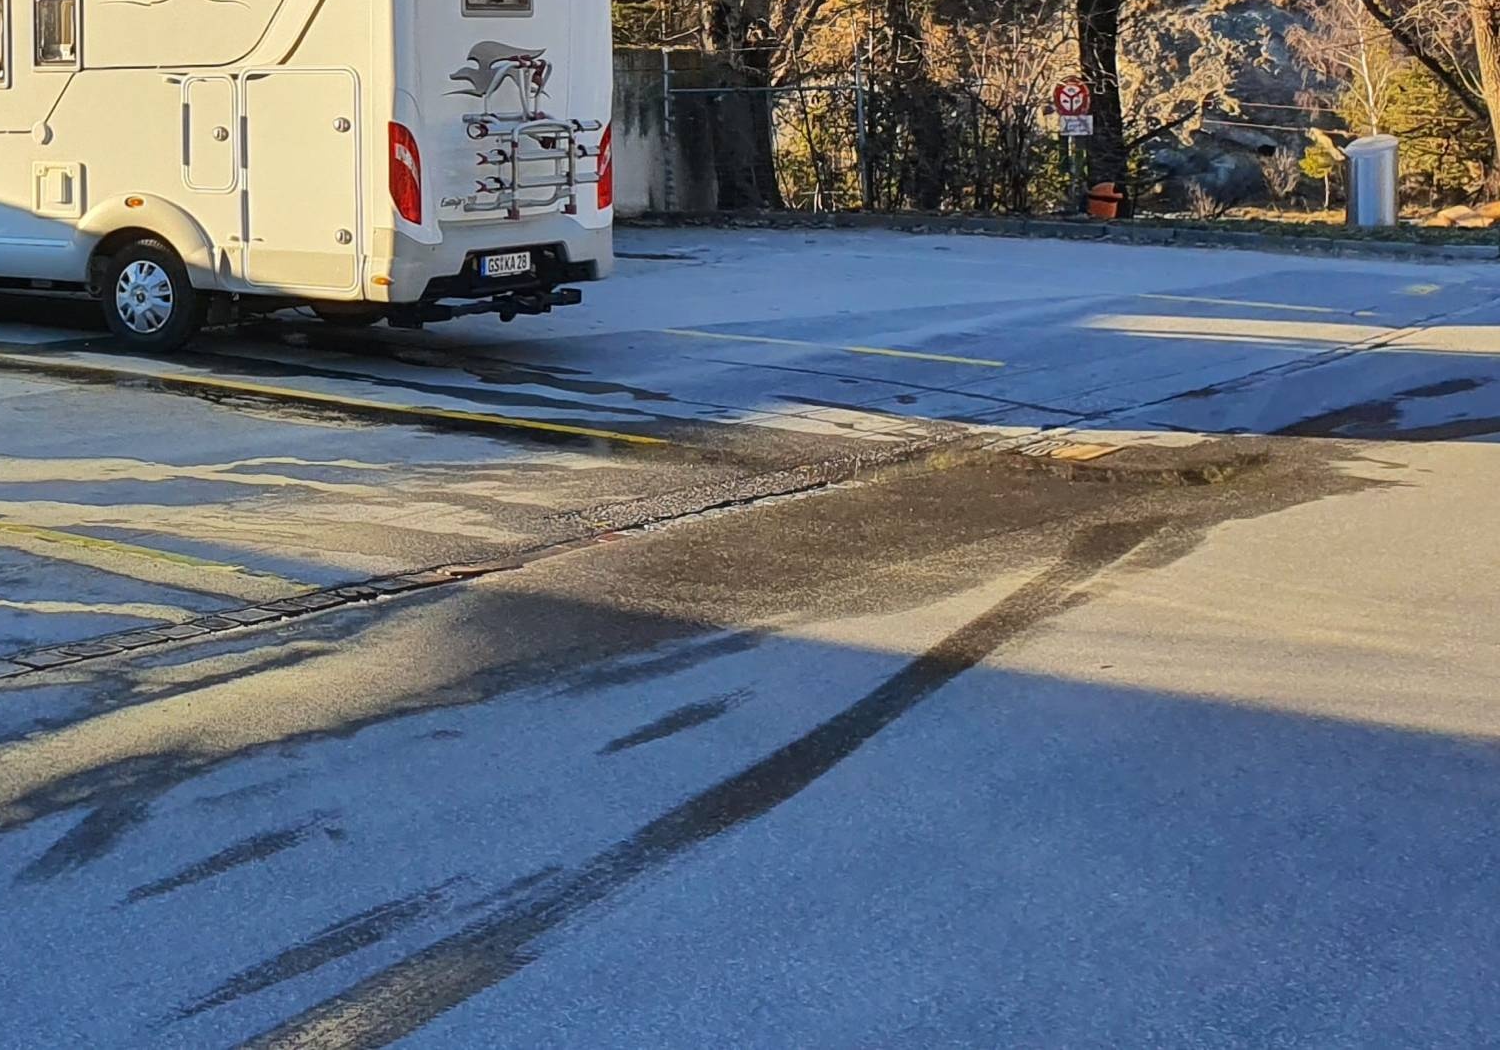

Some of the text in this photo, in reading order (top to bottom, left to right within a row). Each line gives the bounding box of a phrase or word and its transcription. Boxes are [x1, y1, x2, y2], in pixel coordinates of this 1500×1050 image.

[488, 253, 527, 273] GS KA 28
